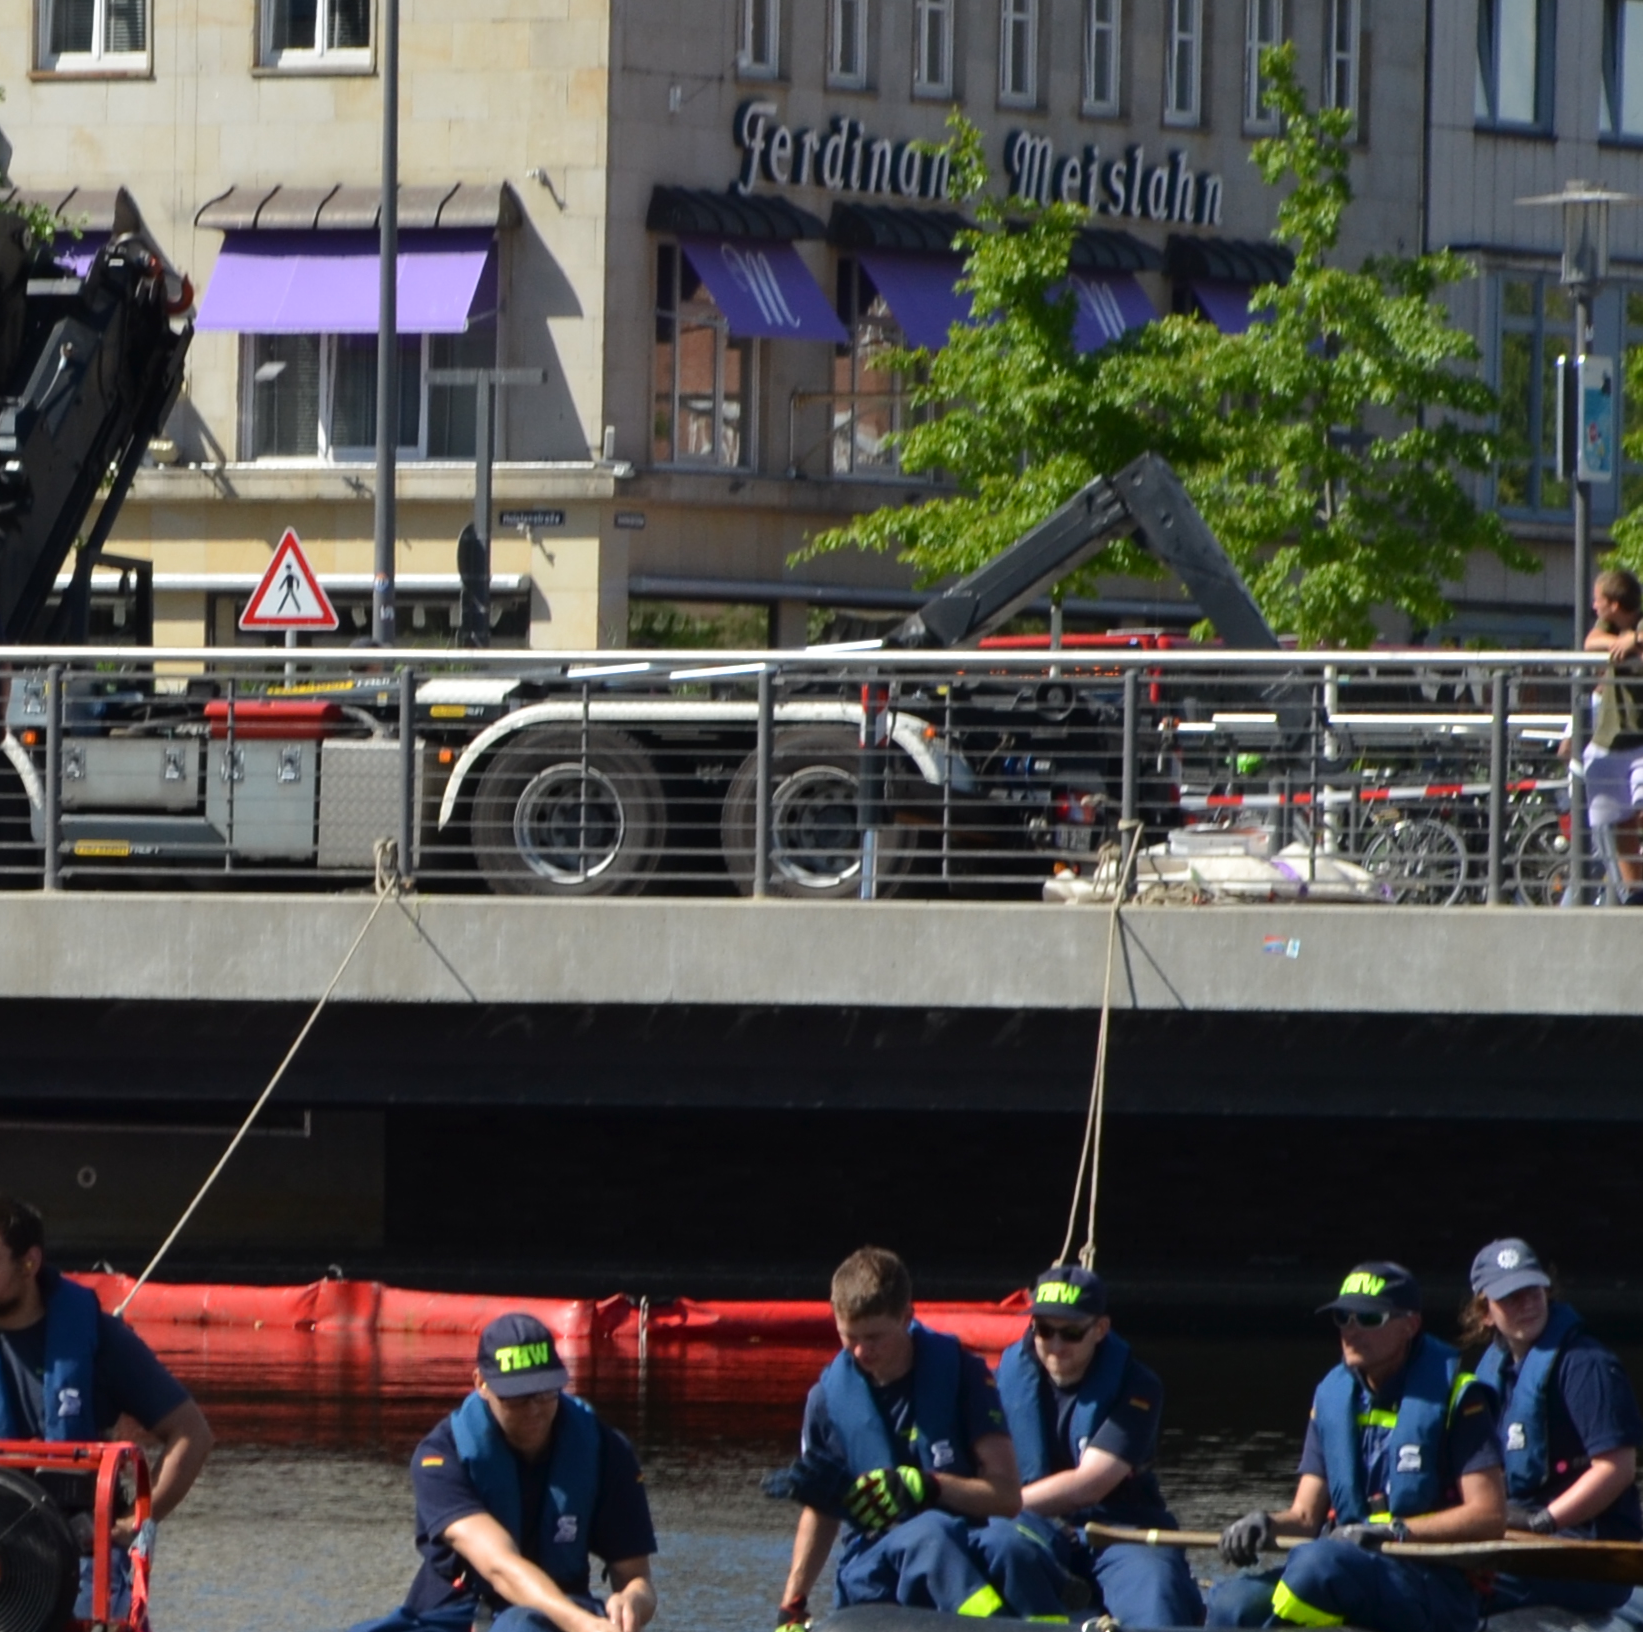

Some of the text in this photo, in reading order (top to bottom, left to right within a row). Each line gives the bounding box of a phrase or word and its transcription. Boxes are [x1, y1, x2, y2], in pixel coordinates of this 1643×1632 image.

[738, 101, 1224, 226] Ferdinan Meislahn
[1035, 1281, 1082, 1304] THW
[1339, 1272, 1387, 1297] THW
[495, 1341, 549, 1373] THW
